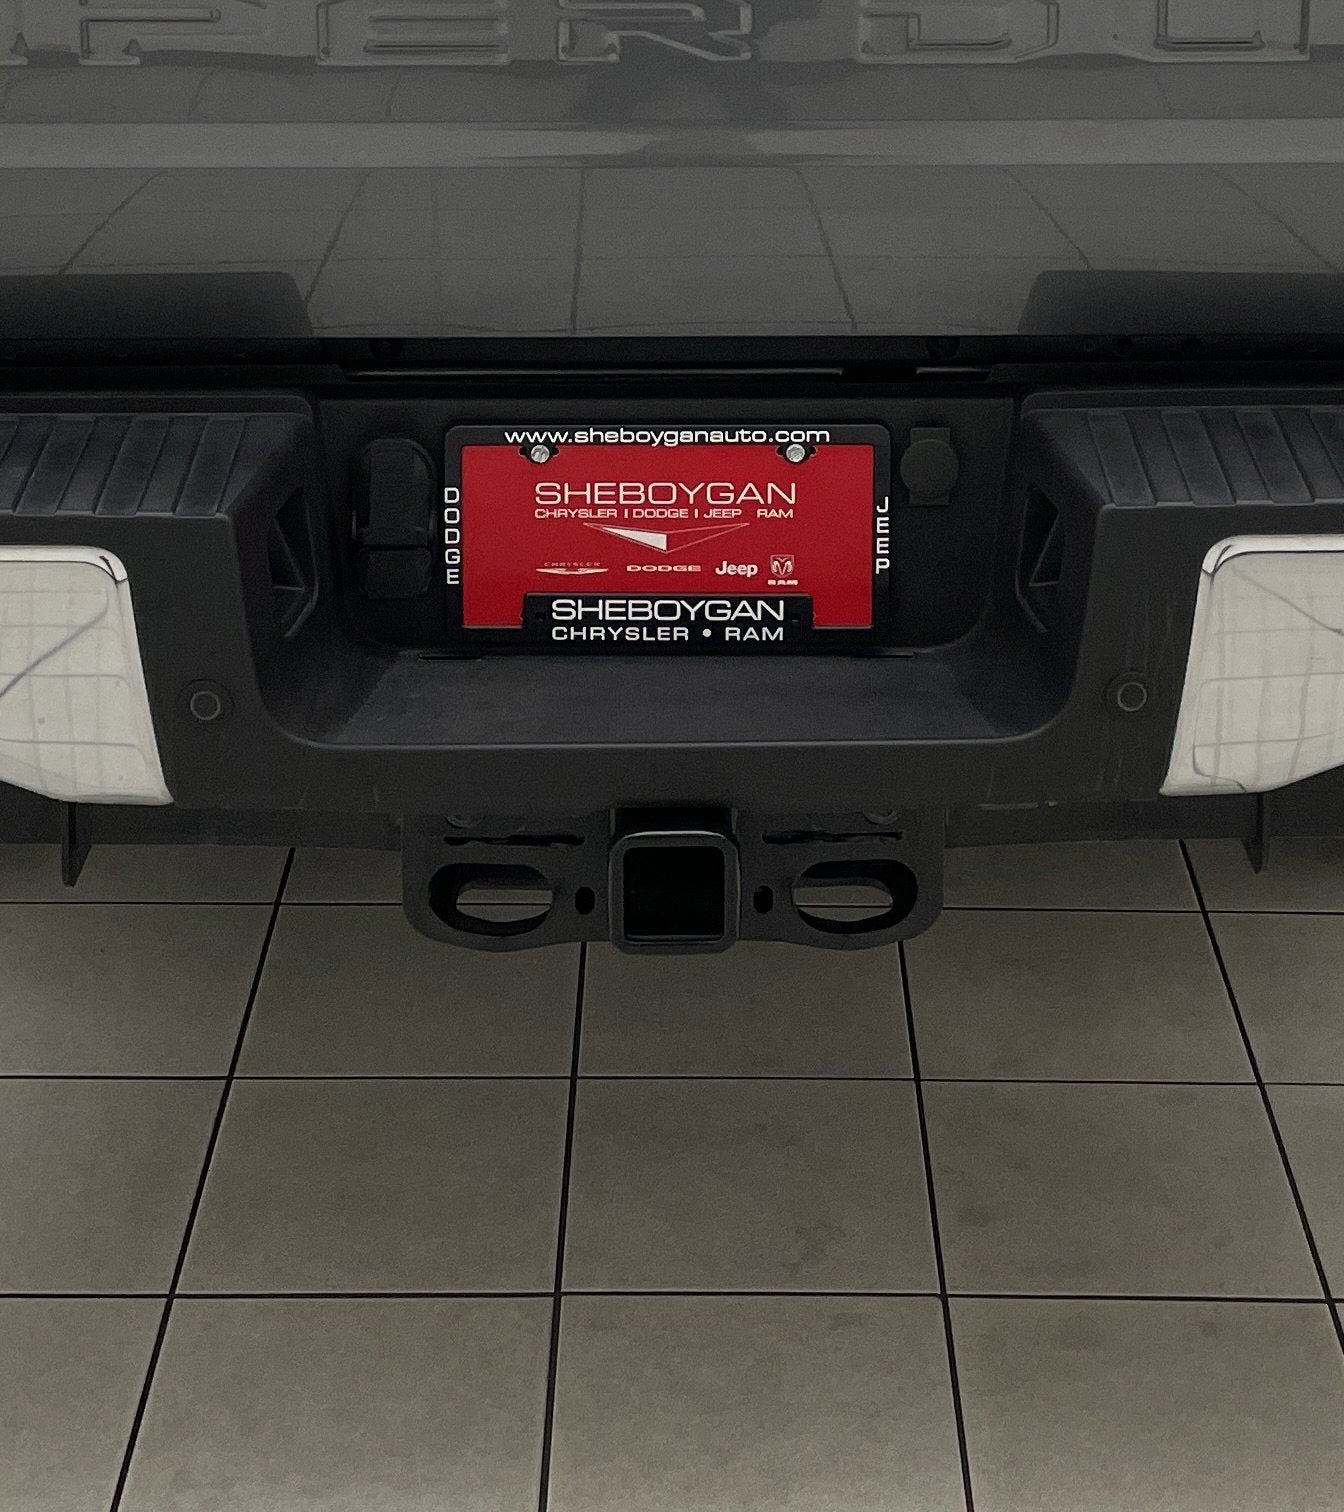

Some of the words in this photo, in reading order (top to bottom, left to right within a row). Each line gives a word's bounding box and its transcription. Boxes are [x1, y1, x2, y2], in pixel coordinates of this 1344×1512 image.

[505, 427, 830, 445] www.sheboyganauto.com
[535, 482, 796, 505] SHEBOYGAN
[535, 508, 618, 519] CHRYSLER
[632, 508, 689, 519] DODGE
[703, 508, 742, 519] JEEP
[756, 508, 794, 519] RAM
[444, 487, 461, 585] DODGE
[875, 496, 890, 575] JEEP
[626, 564, 702, 573] DODGE
[715, 560, 758, 578] Jeep
[551, 599, 784, 622] SHEBOYGAN
[551, 626, 690, 642] CHRYSLER
[724, 626, 784, 642] RAM
